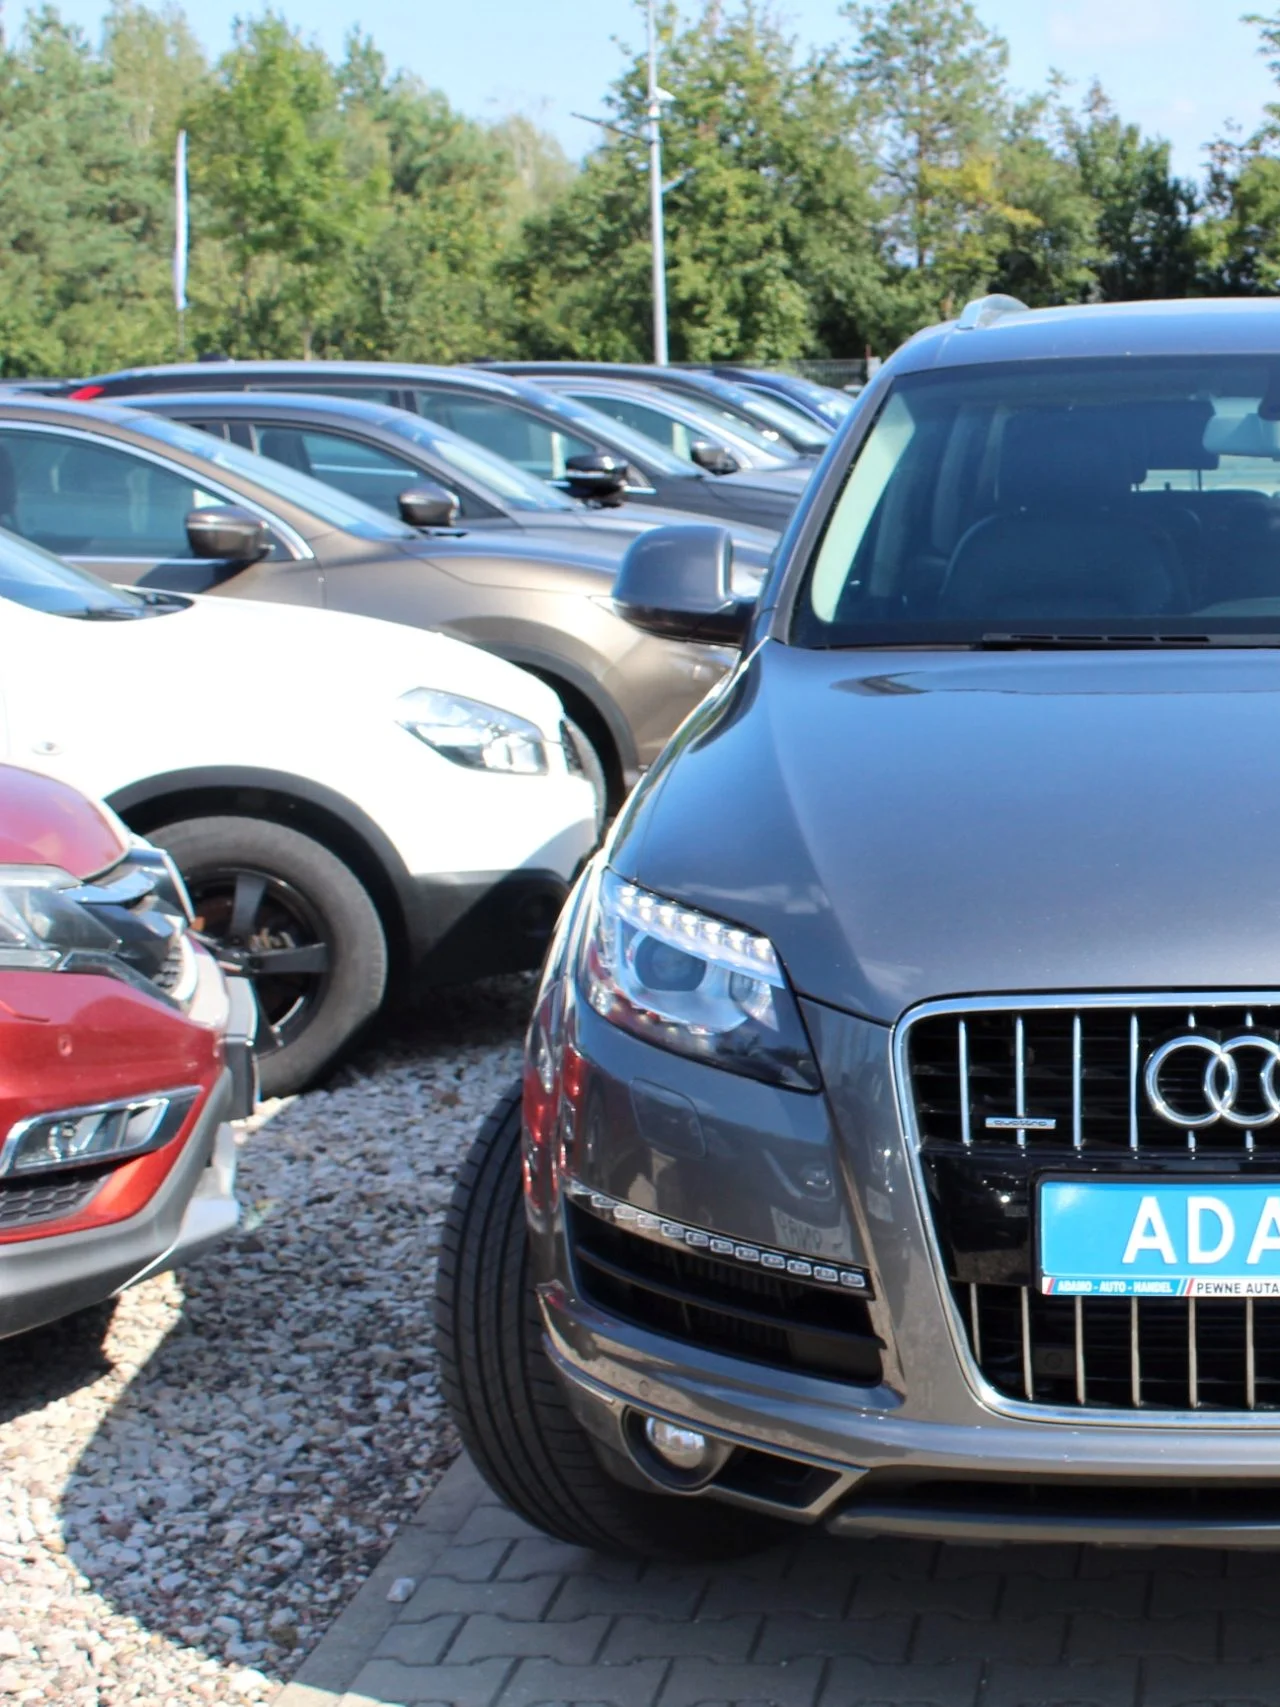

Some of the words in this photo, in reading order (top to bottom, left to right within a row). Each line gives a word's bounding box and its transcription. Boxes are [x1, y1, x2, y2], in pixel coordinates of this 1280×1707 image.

[1099, 1281, 1126, 1293] AUTO
[1197, 1282, 1242, 1294] PEWNE
[1246, 1282, 1280, 1294] AUTA
